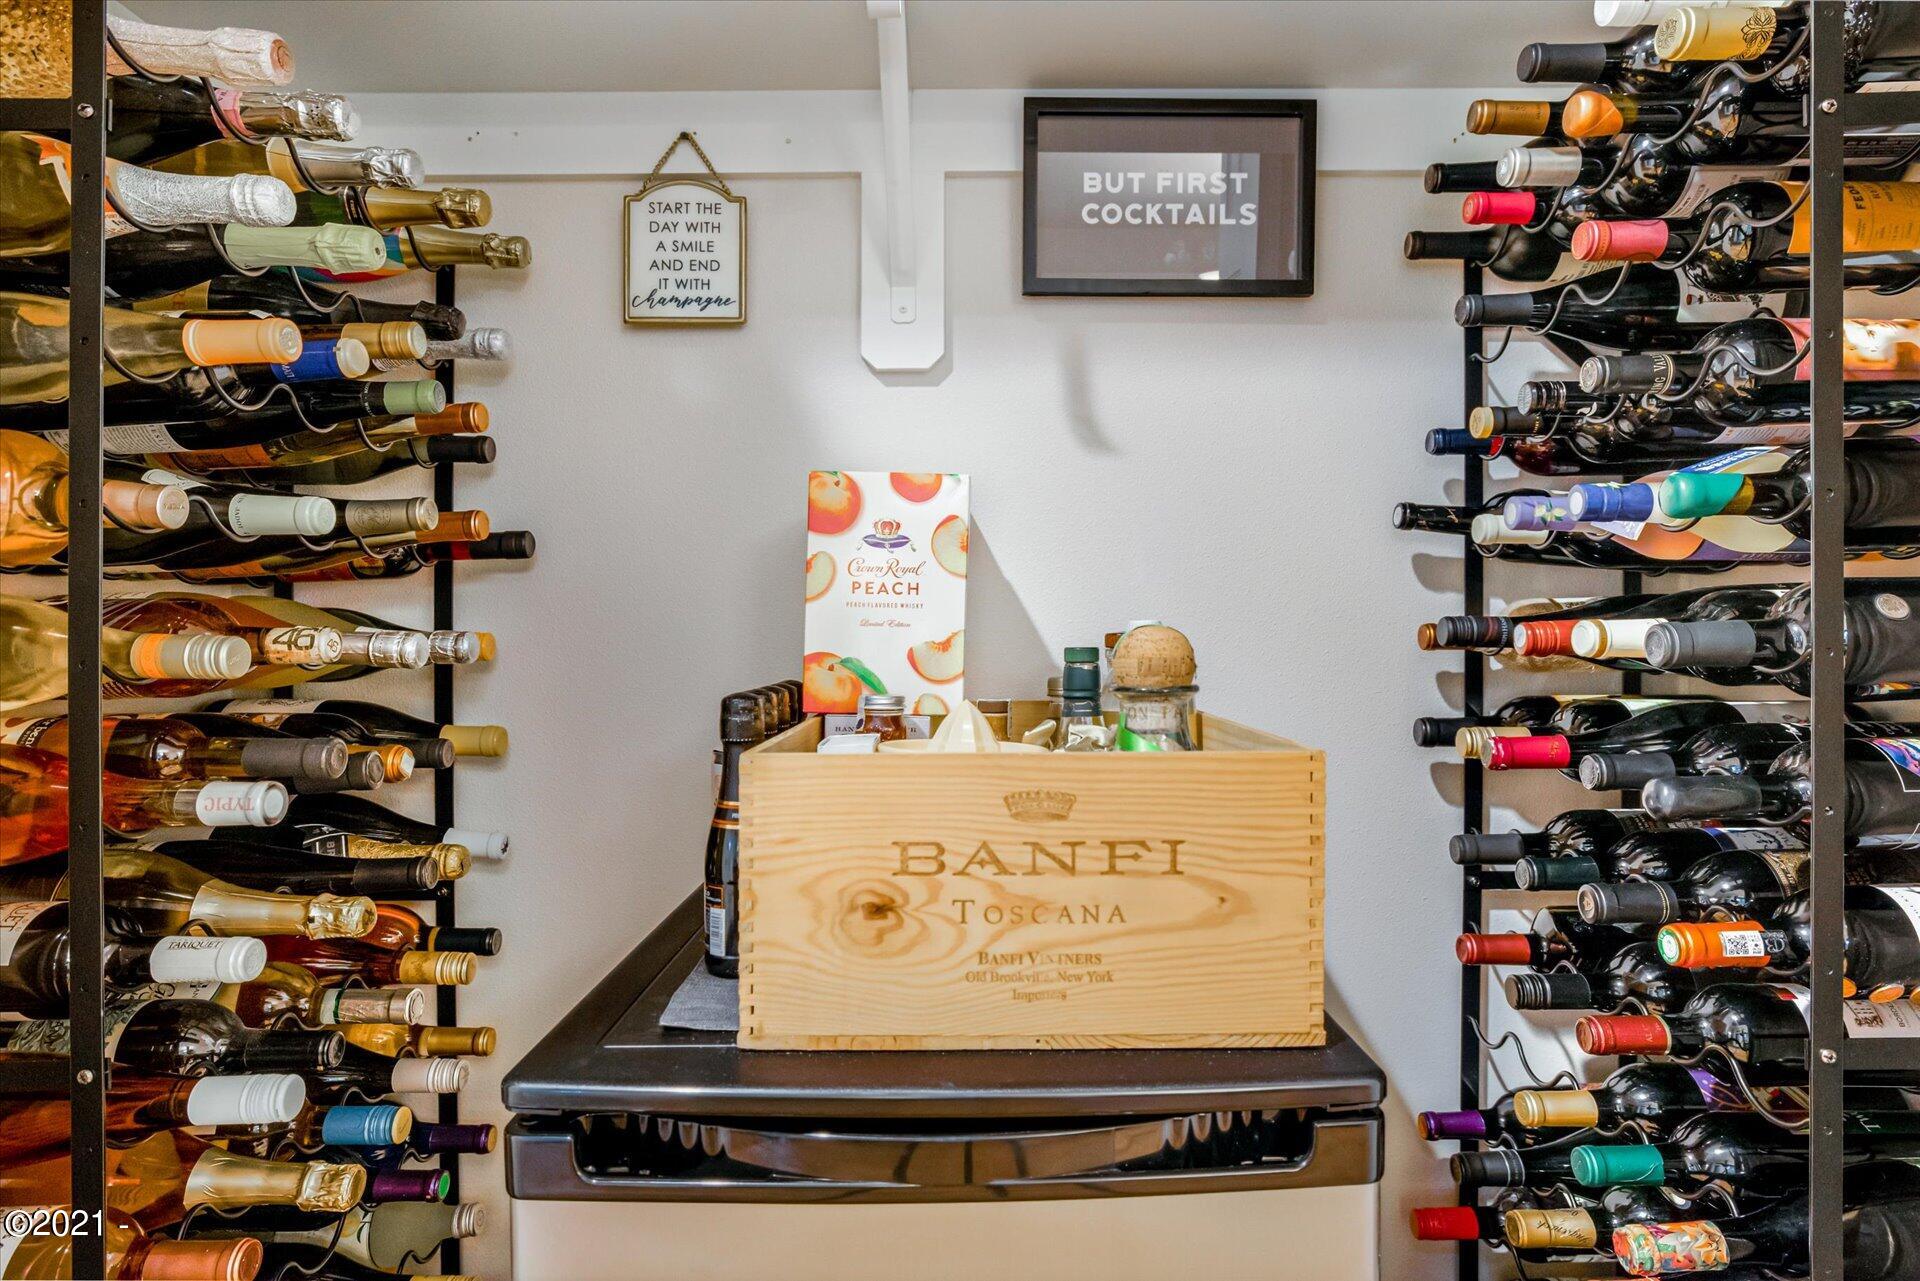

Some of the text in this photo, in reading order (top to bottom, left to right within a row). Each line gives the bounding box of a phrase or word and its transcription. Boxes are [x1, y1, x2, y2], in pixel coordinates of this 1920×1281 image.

[1083, 171, 1249, 195] BUT FIRST
[648, 201, 722, 215] START THE
[1081, 202, 1257, 226] COCKTAILS
[649, 221, 721, 234] DAY WITH
[655, 240, 715, 253] A SMILE
[649, 259, 721, 272] AND END
[658, 278, 711, 291] IT WITH
[632, 288, 736, 312] champagne
[847, 557, 927, 579] Crown Royal
[851, 580, 920, 596] PEACH
[203, 796, 255, 812] TYPIC
[891, 839, 1186, 877] BANFI
[167, 940, 222, 950] TARIQUET
[977, 951, 1024, 966] BANFI
[964, 971, 988, 983] Old
[1057, 971, 1083, 983] New
[1086, 970, 1115, 983] York
